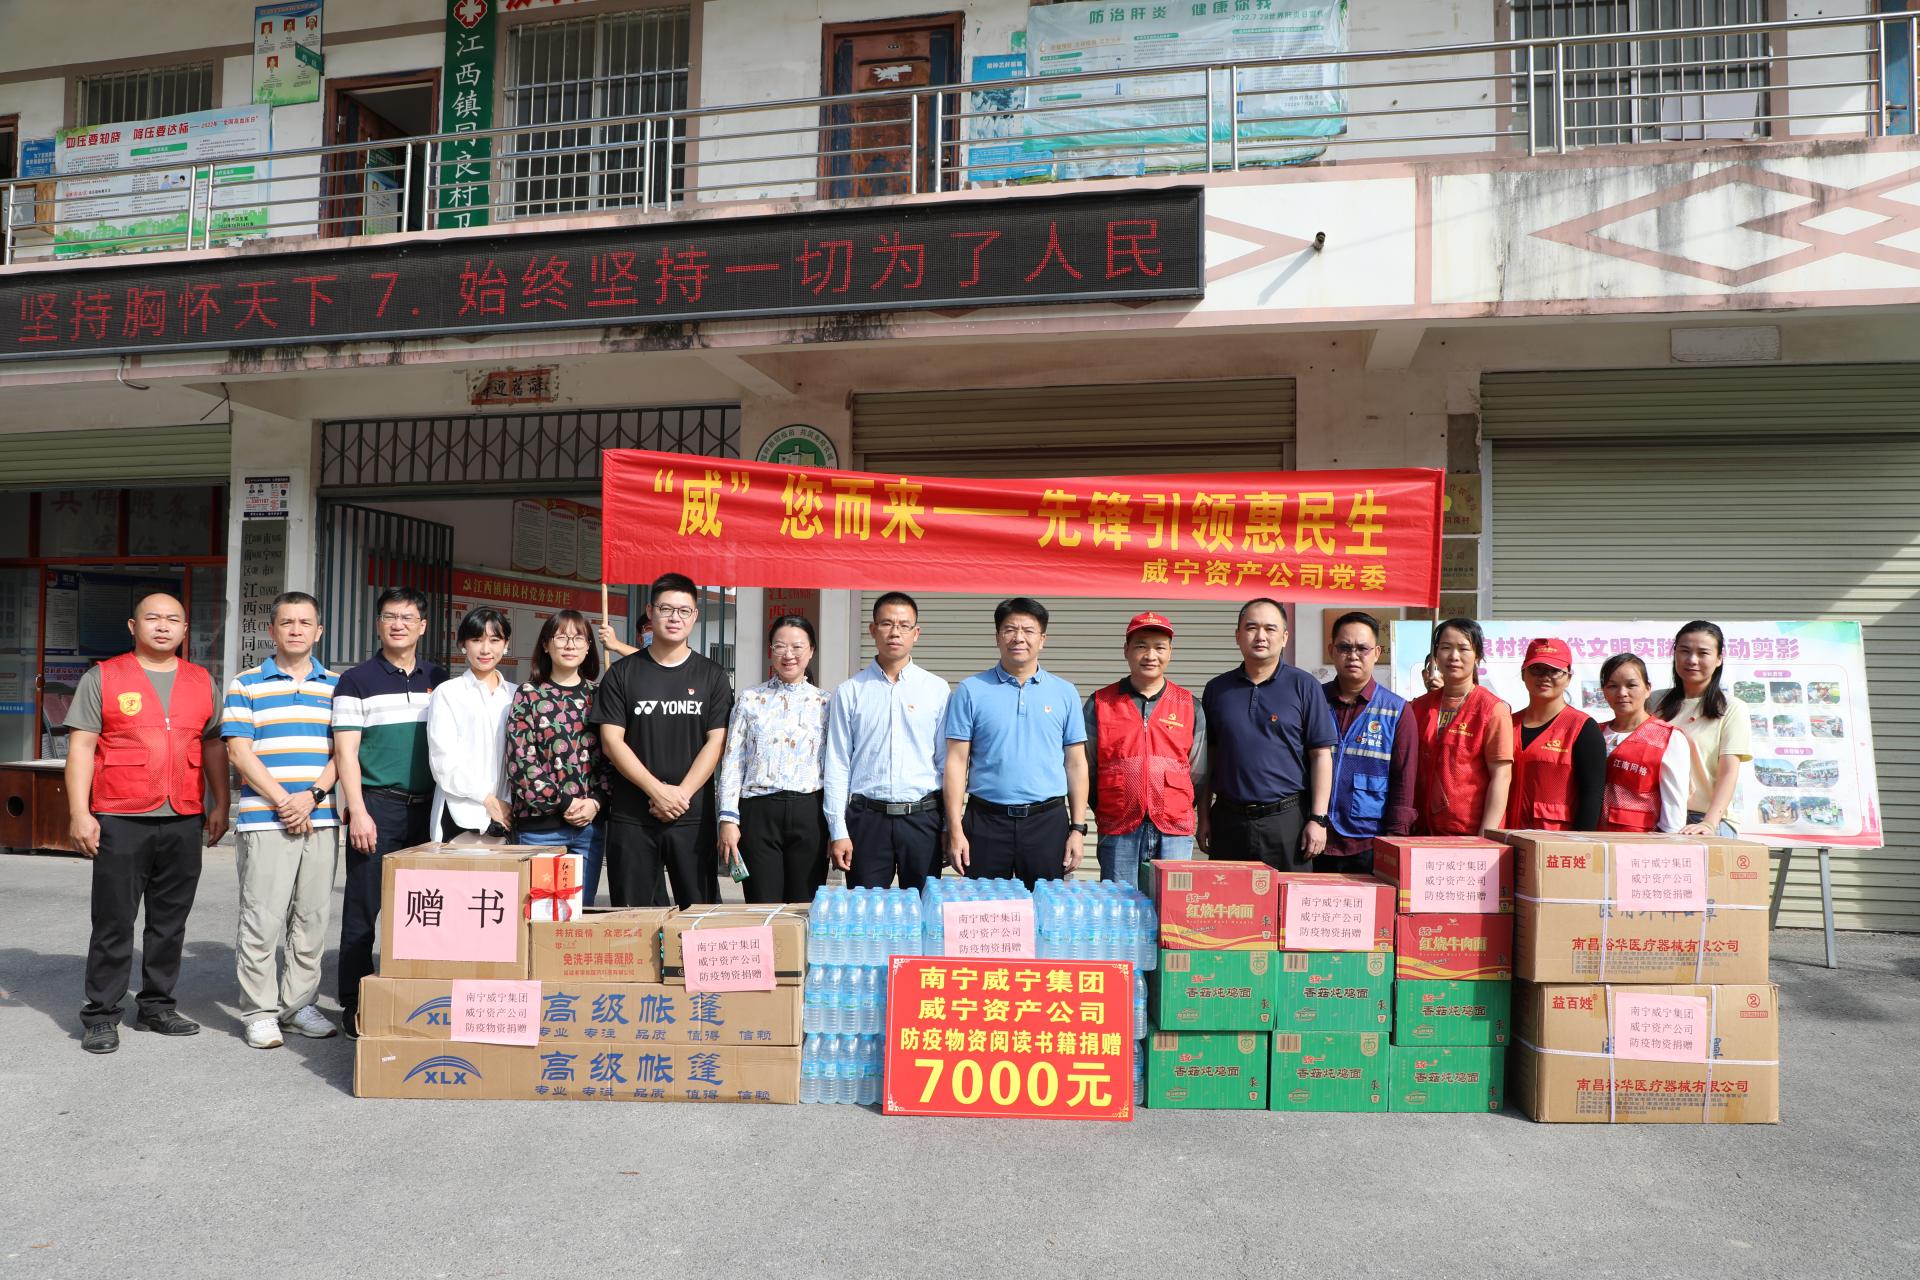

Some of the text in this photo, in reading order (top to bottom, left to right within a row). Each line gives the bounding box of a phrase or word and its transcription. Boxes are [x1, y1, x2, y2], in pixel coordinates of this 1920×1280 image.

[1089, 0, 1272, 24] 防治肝炎 健康你我
[18, 274, 338, 343] 坚持胸怀天下
[459, 218, 1164, 316] 始终坚持一切为了人民
[1140, 558, 1388, 591] 威宁资产公司党委
[660, 700, 704, 715] YONEX
[1425, 860, 1487, 871] 南宁威宁集团
[1546, 855, 1587, 869] 益百姓
[1631, 857, 1692, 868] 南宁威宁集团
[1424, 876, 1487, 886] 威宁资产公司
[1631, 873, 1693, 884] 威宁资产公司
[1424, 890, 1487, 901] 防疫物资捐赠
[1631, 888, 1693, 899] 防疫物资捐赠
[1301, 896, 1364, 909] 南宁威宁集团
[959, 911, 1021, 925] 南宁威宁集团
[1185, 903, 1255, 919] 红烧牛肉面
[1300, 911, 1363, 924] 威宁资产公司
[555, 928, 593, 938] 共抗疫情
[959, 927, 1022, 940] 威宁资产公司
[1299, 927, 1362, 939] 防疫物资捐赠
[697, 938, 760, 952] 南宁威宁集团
[959, 942, 1022, 955] 防疫物资捐赠
[1418, 936, 1489, 952] 红烧牛肉面
[563, 952, 634, 966] 免洗手消毒凝胶
[698, 954, 761, 967] 威宁资产公司
[699, 970, 762, 983] 防疫物资捐赠
[919, 967, 1105, 994] 南宁威宁集团
[465, 992, 528, 1005] 南宁威宁集团
[1186, 987, 1252, 998] 香菇炖鸡面
[1304, 987, 1369, 998] 香菇炖鸡面
[542, 992, 726, 1026] 高级帐篷
[1552, 995, 1593, 1009] 益百姓
[465, 1007, 528, 1019] 威宁资产公司
[918, 998, 1105, 1024] 威宁资产公司
[1421, 1005, 1487, 1017] 香菇炖鸡面
[1630, 1005, 1694, 1020] 南宁威宁集团
[427, 1012, 452, 1026] XL
[464, 1021, 528, 1034] 防疫物资捐赠
[584, 1027, 617, 1039] 专注
[635, 1029, 666, 1041] 品质
[687, 1029, 720, 1042] 值得
[1629, 1021, 1694, 1035] 威宁资产公司
[900, 1027, 1122, 1056] 防疫物资阅读书籍捐赠
[1629, 1037, 1693, 1051] 防疫物资捐赠
[540, 1050, 725, 1085] 高级帐篷
[1174, 1065, 1240, 1077] 香菇炖鸡面
[1297, 1067, 1362, 1079] 香菇炖鸡面
[424, 1070, 470, 1085] XLX
[914, 1059, 1113, 1107] 7000元
[1414, 1071, 1480, 1083] 香菇炖鸡面
[535, 1085, 568, 1097] 专业
[634, 1087, 665, 1099] 品质
[685, 1088, 718, 1100] 值得
